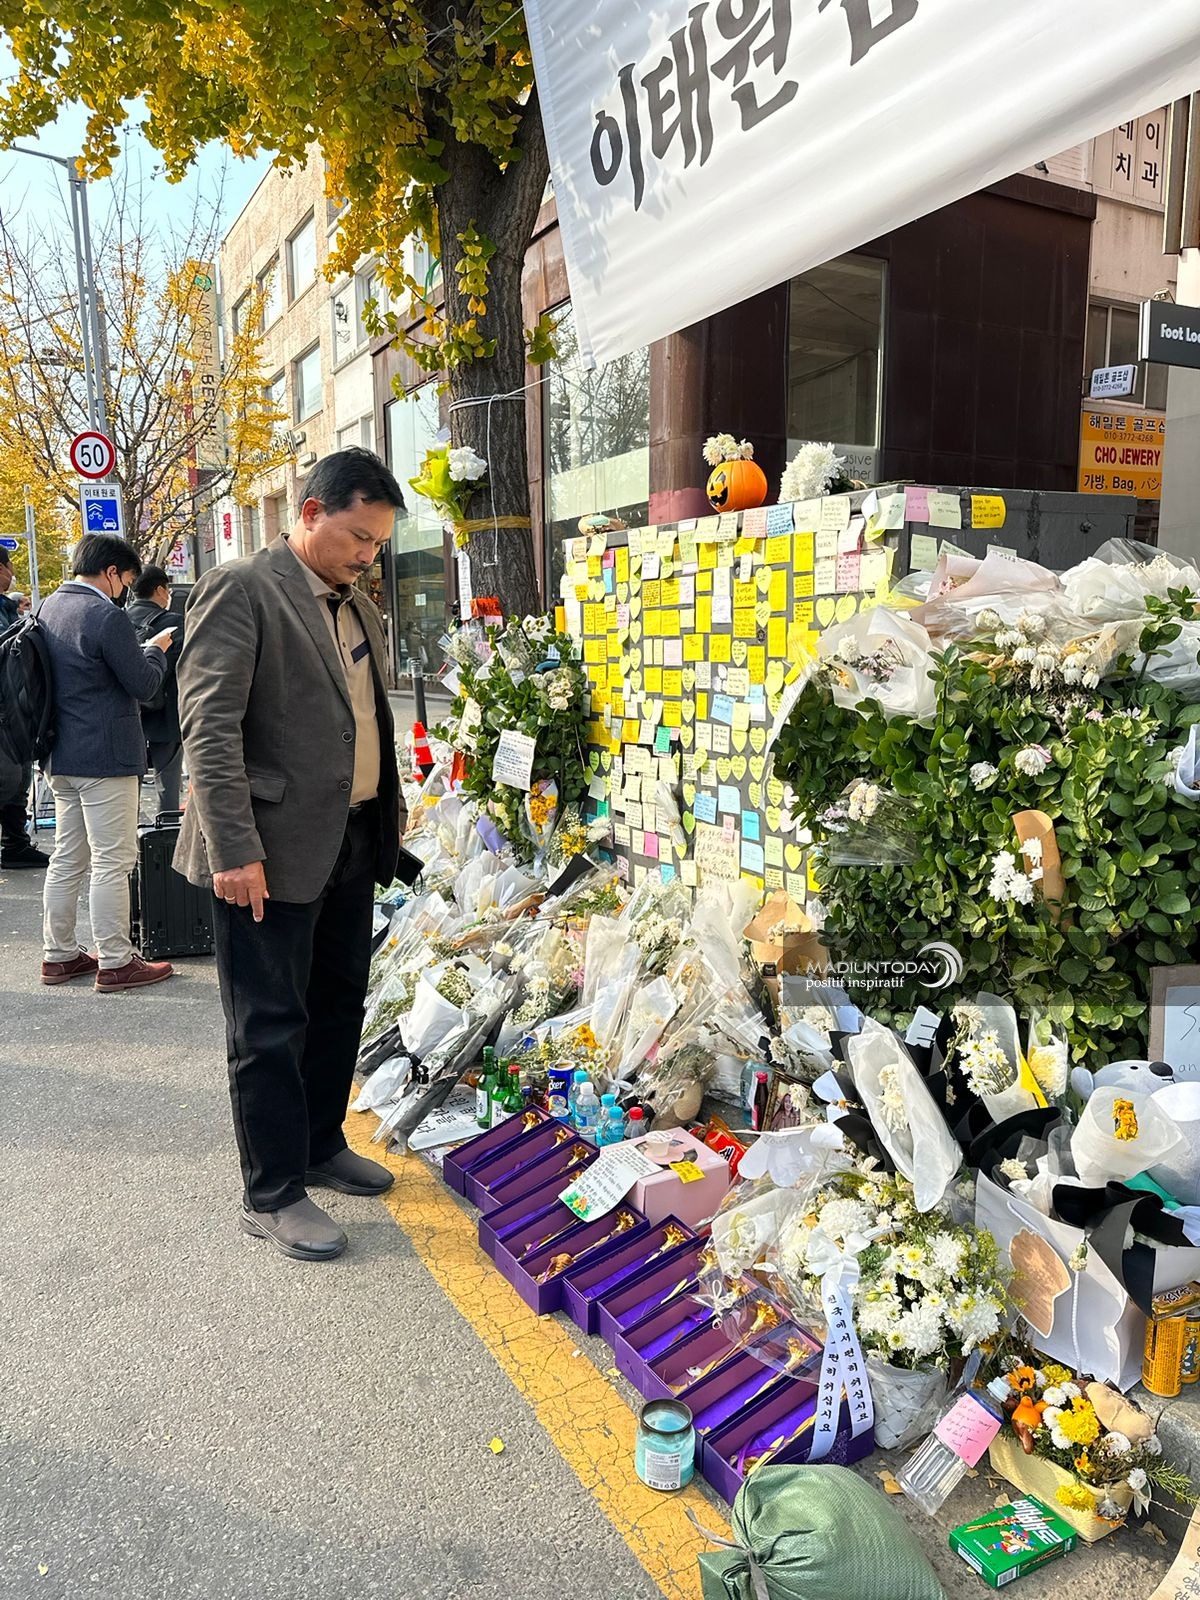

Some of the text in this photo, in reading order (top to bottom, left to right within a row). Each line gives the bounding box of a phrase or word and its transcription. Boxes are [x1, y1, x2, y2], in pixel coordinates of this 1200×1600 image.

[590, 0, 799, 212] 이태원
[1115, 152, 1159, 188] 치과
[1160, 323, 1184, 341] Foot
[1089, 415, 1126, 431] 해밀톤
[1103, 431, 1154, 443] 010-3772-4268
[80, 443, 105, 468] 50
[1094, 445, 1161, 466] CHO JEWERY
[84, 487, 116, 498] 이태원로
